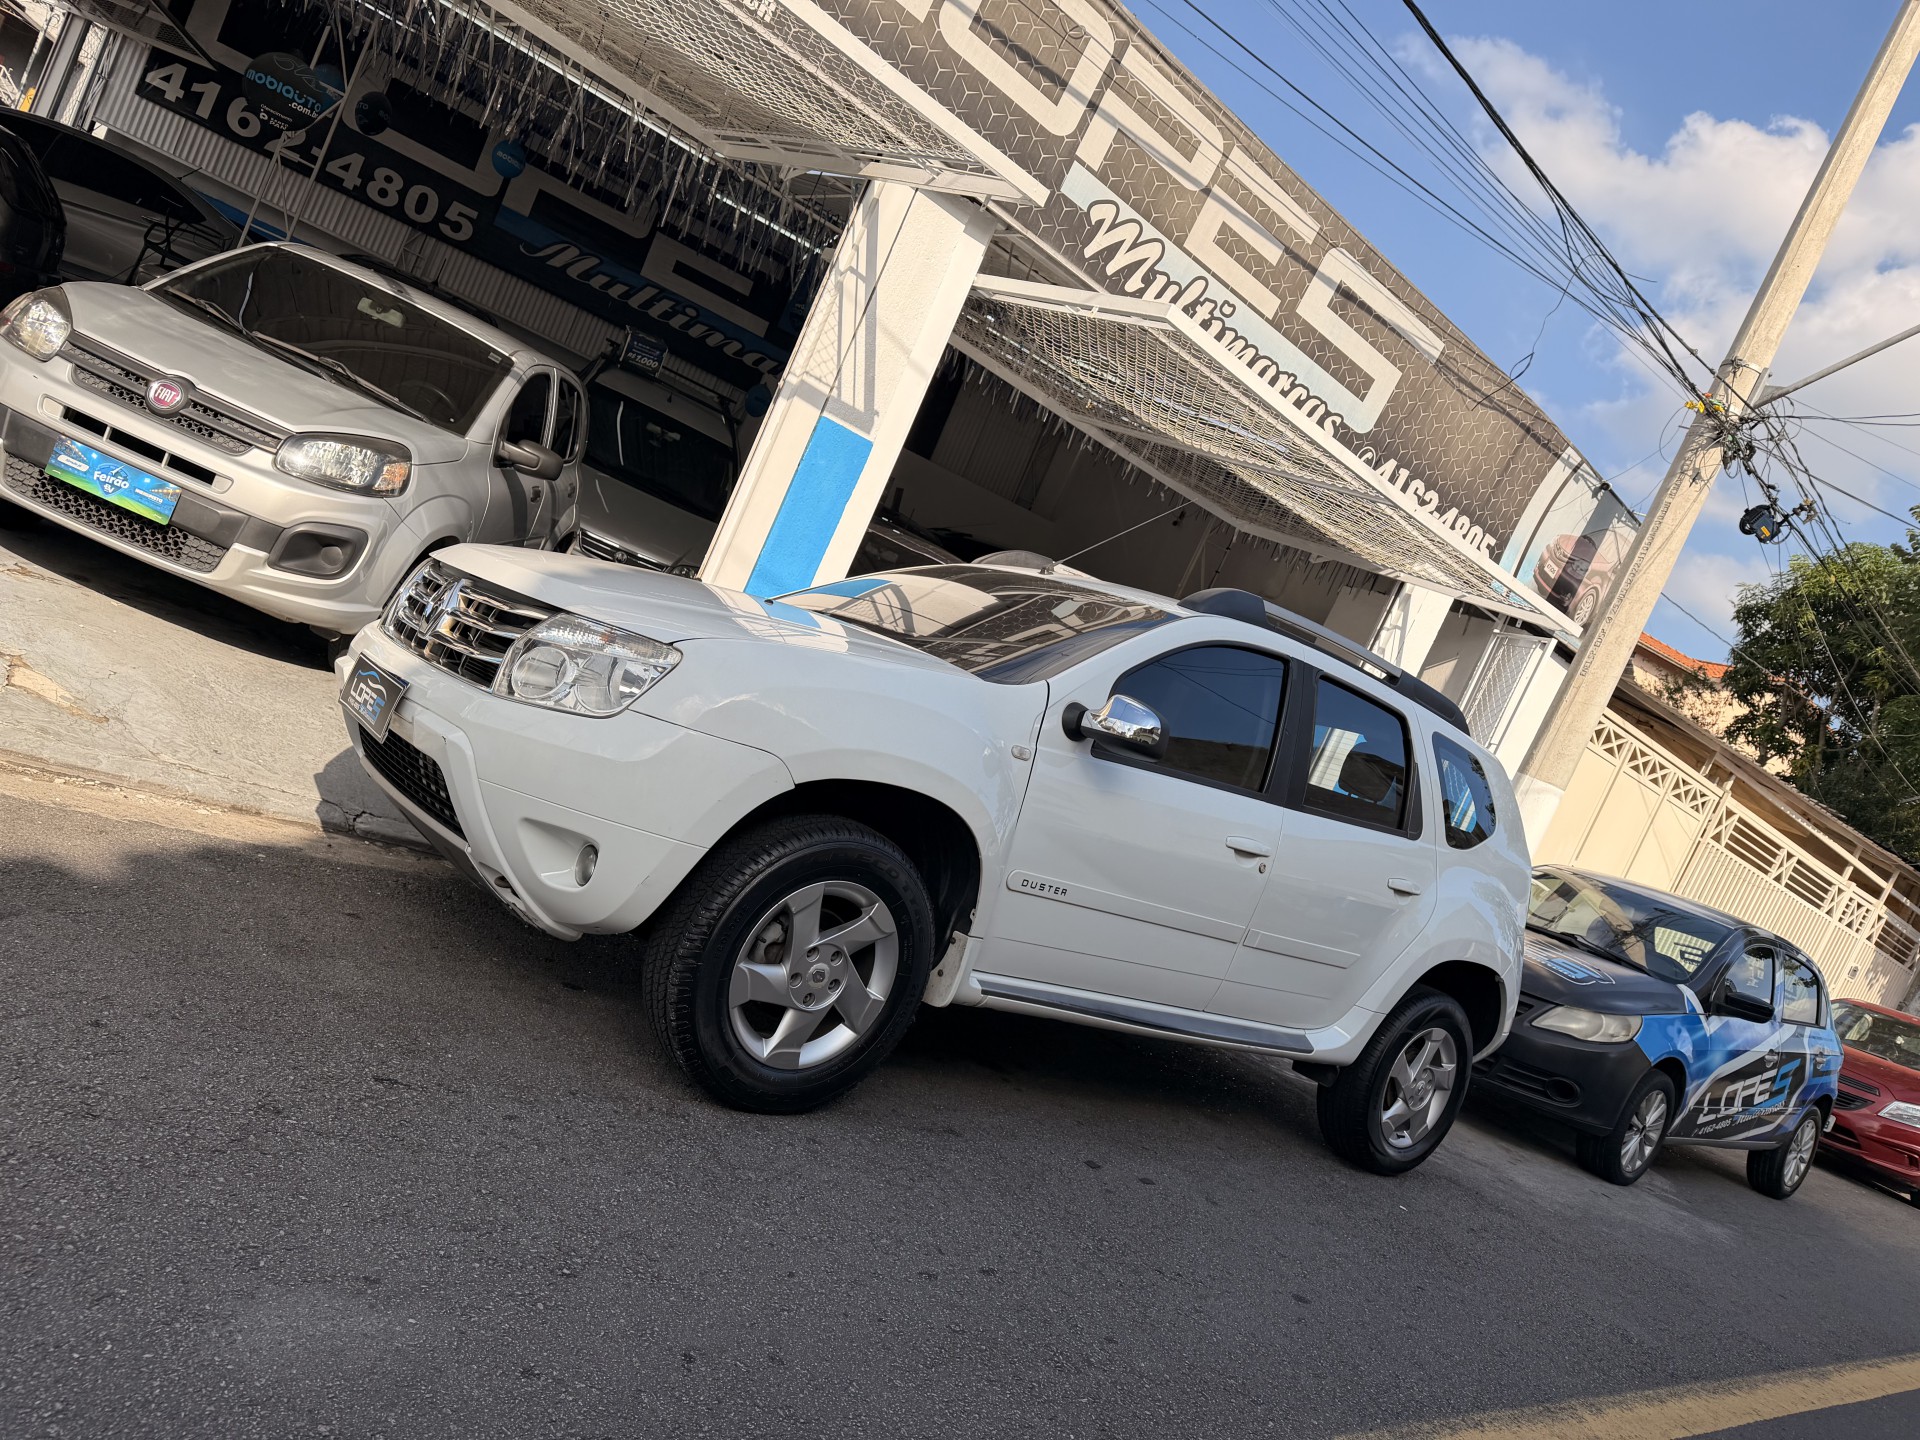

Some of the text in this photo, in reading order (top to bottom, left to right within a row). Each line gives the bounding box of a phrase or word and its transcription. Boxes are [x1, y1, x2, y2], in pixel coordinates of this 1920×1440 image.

[888, 0, 1446, 434] OPES
[155, 386, 177, 402] FIAT
[94, 470, 130, 489] Feirão
[1021, 878, 1068, 896] DUSTER
[1697, 1058, 1802, 1125] LOPES
